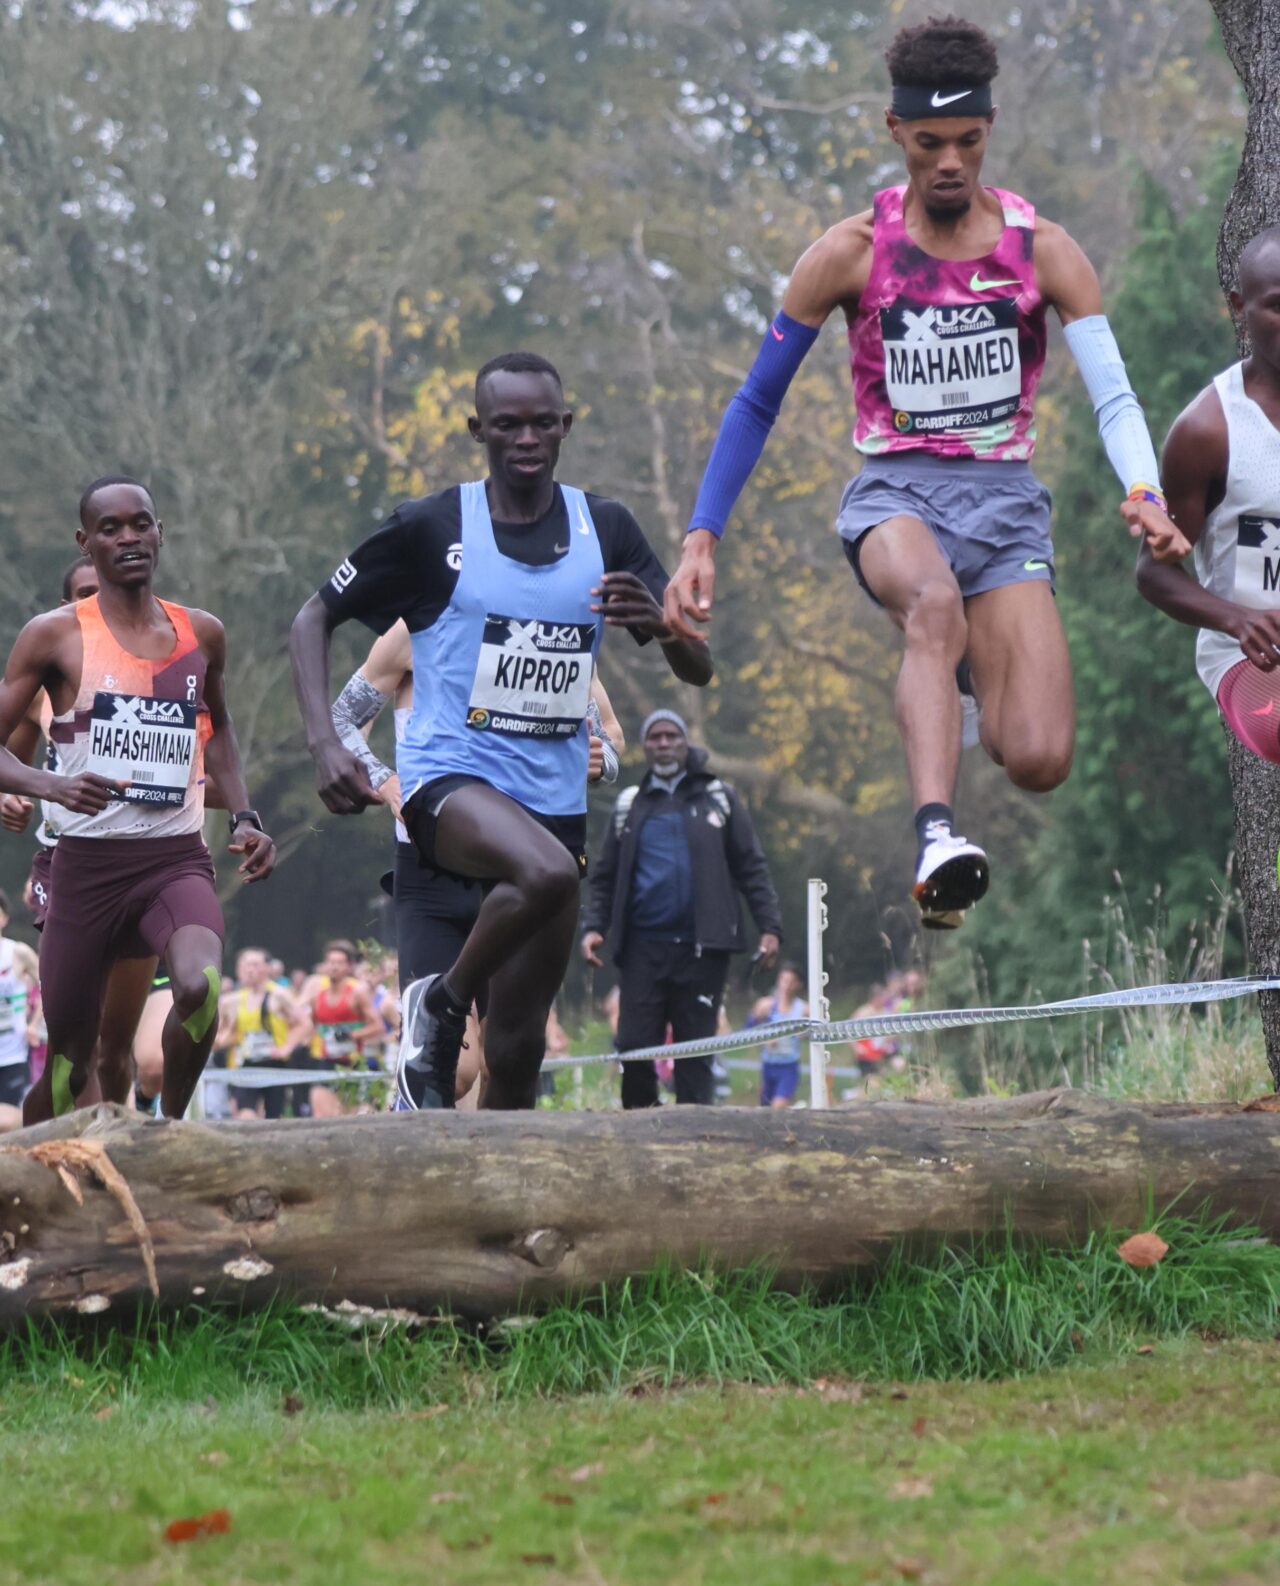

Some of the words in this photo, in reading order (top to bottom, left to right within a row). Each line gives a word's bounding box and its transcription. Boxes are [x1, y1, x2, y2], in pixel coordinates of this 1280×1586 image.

[889, 336, 1015, 385] MAHAMED
[494, 653, 580, 694] KIPROP
[92, 724, 191, 767] HAFASHIMANA
